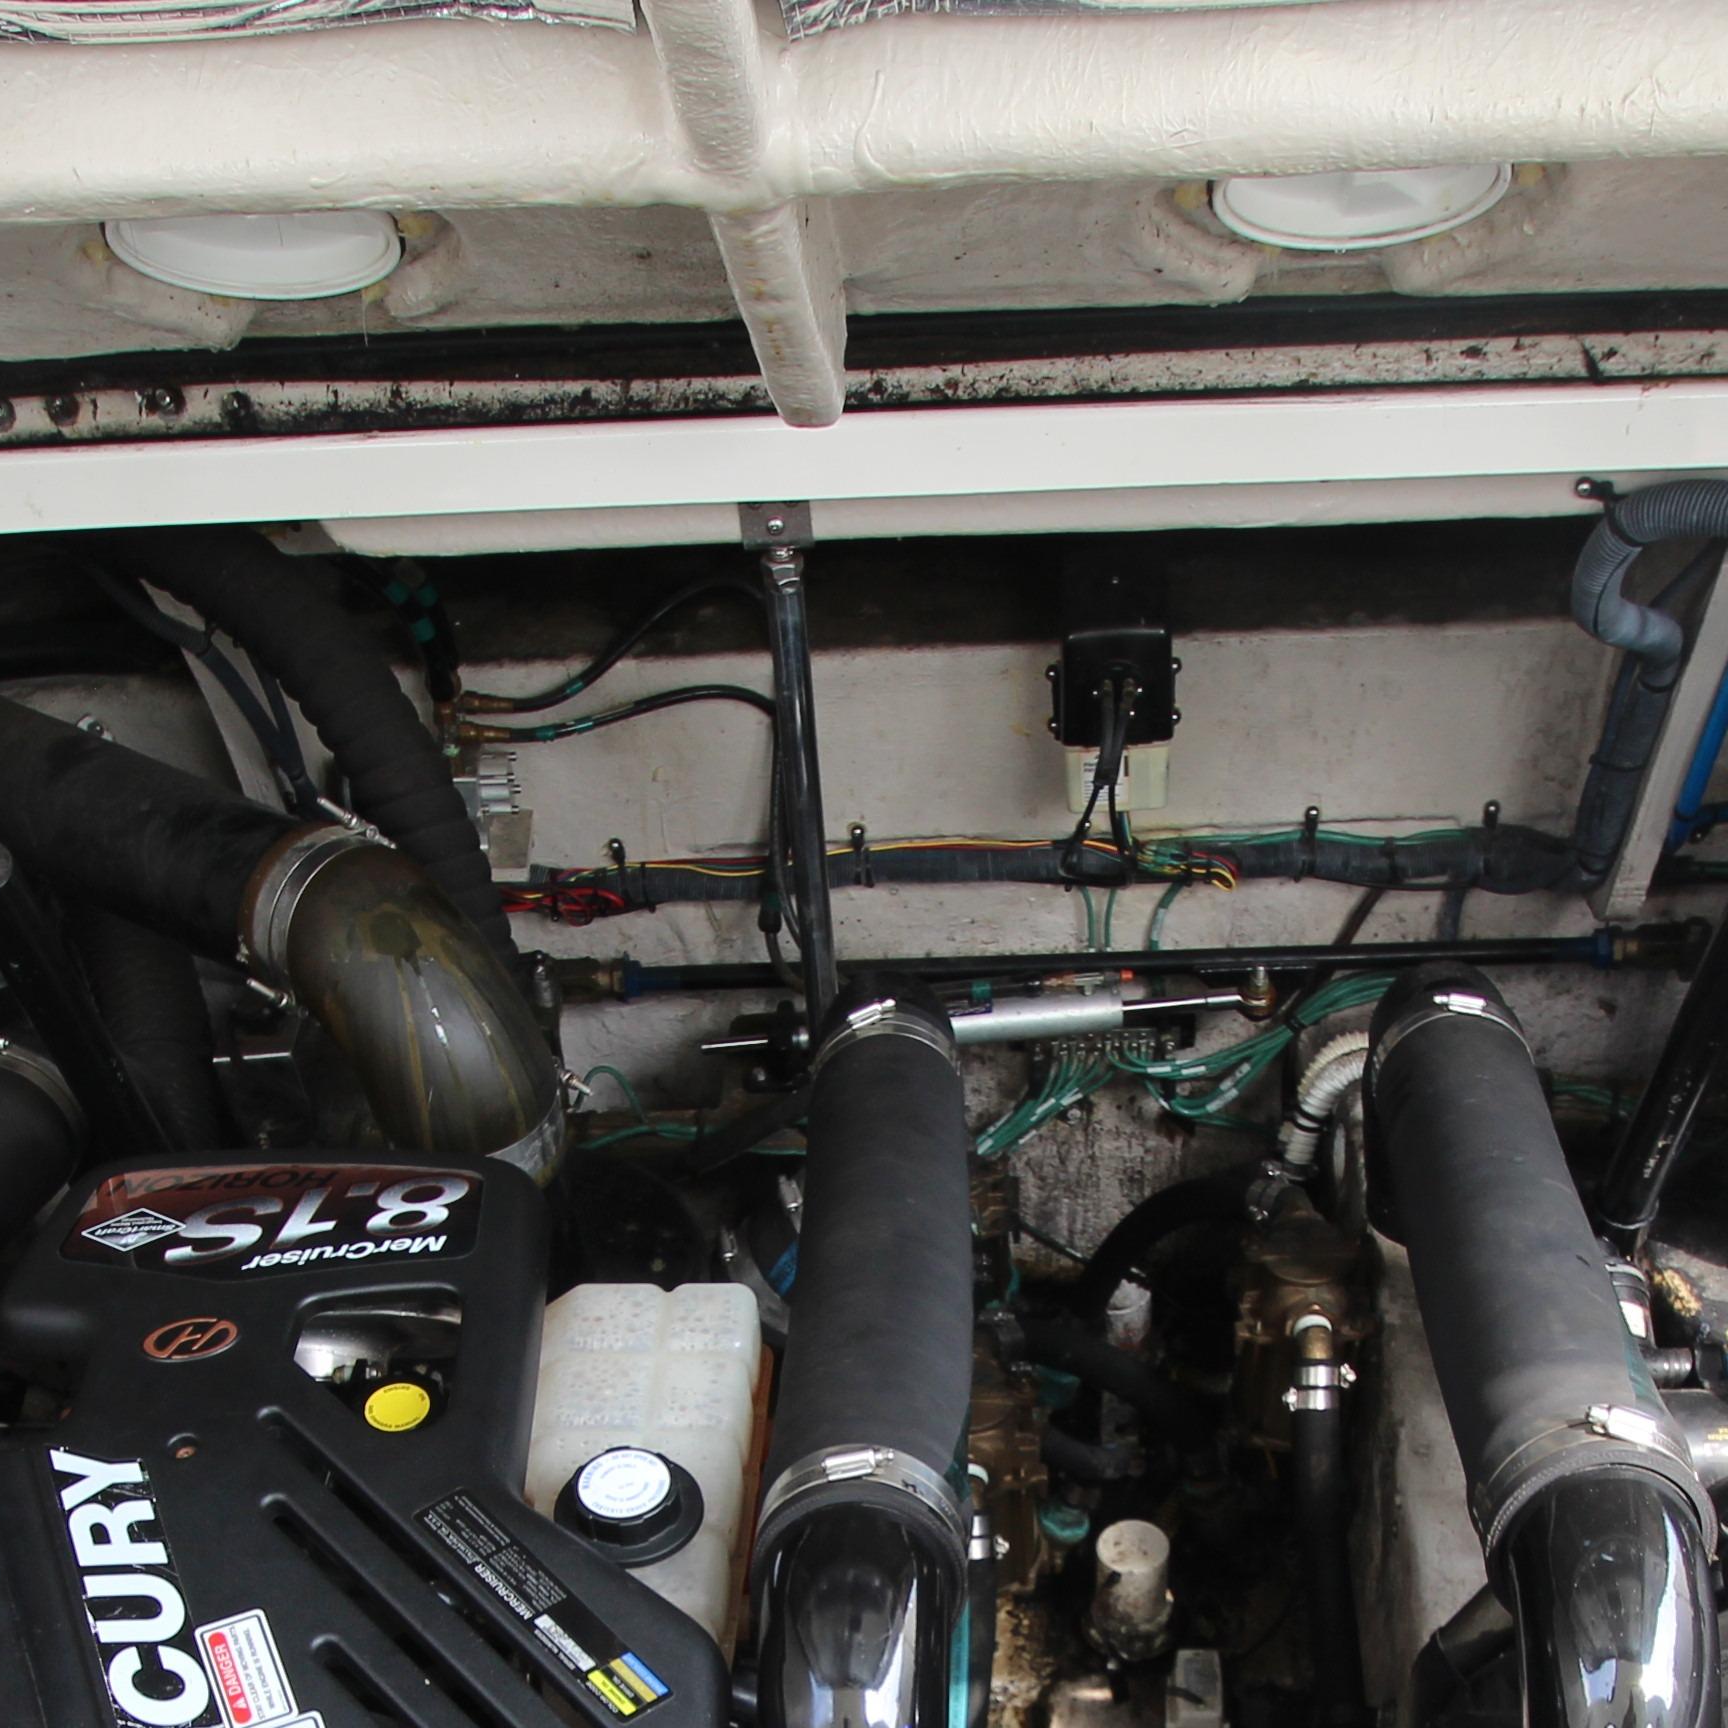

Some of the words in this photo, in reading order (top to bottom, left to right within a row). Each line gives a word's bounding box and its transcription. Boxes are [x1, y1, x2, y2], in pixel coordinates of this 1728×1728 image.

[105, 1169, 339, 1197] HORIZON
[164, 1176, 470, 1263] 8.1S
[241, 1236, 447, 1271] MerCruiser
[473, 1561, 533, 1621] MERCRUISER
[212, 1642, 241, 1696] DANGER
